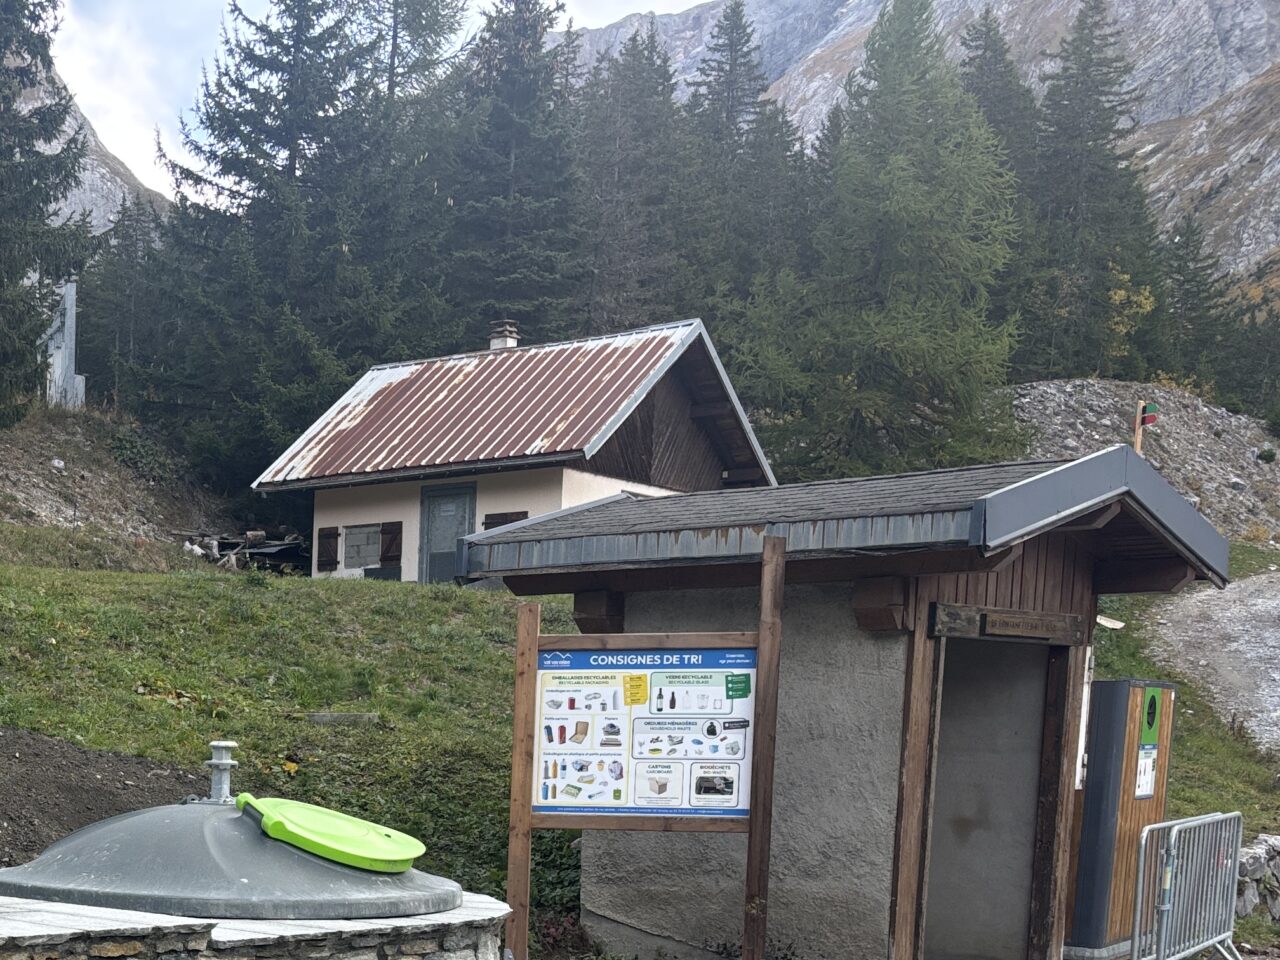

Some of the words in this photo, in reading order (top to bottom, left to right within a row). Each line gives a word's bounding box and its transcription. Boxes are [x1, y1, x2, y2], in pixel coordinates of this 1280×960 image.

[590, 655, 661, 665] CONSIGNES
[663, 654, 680, 664] DE
[682, 654, 702, 664] TRI
